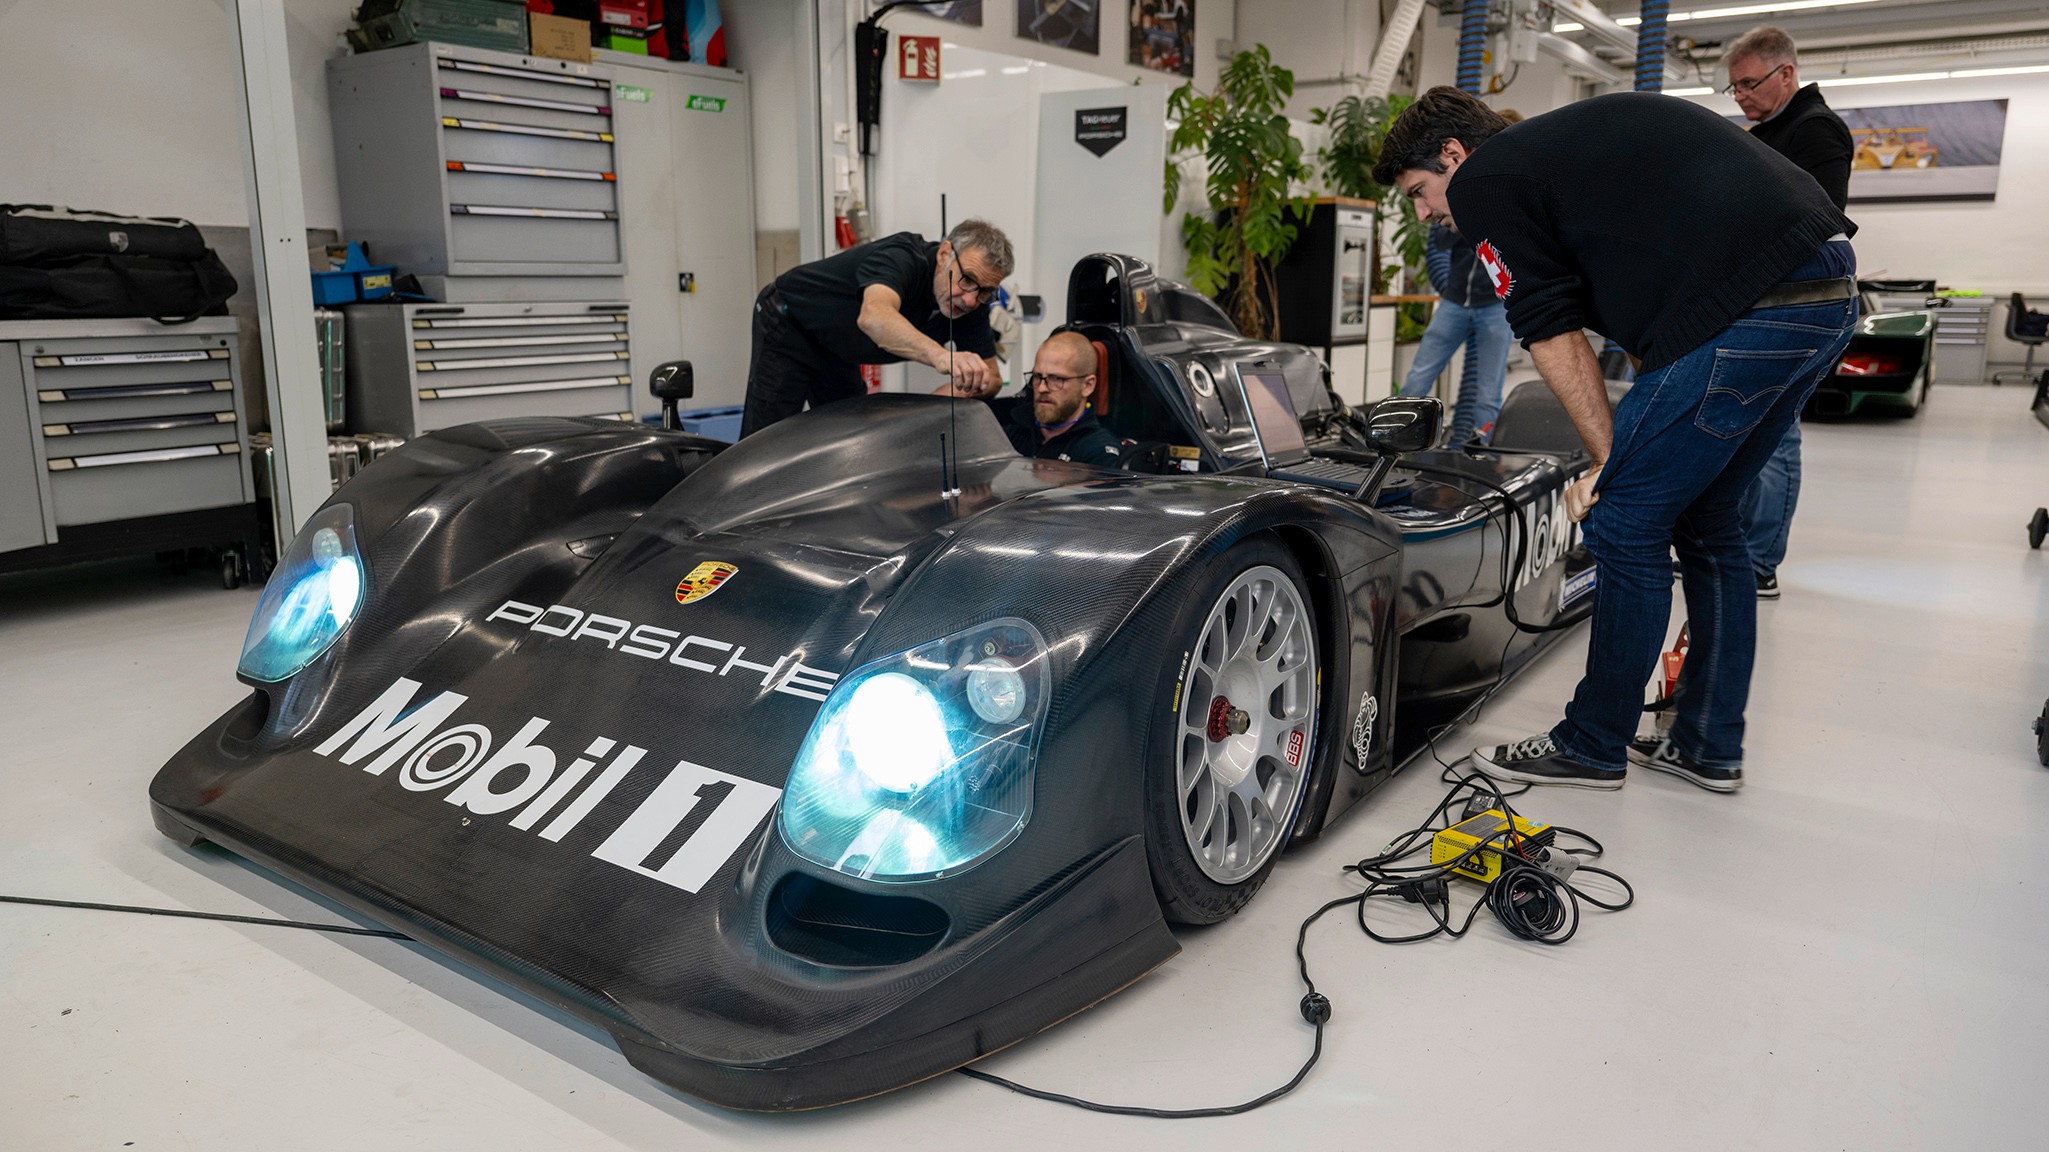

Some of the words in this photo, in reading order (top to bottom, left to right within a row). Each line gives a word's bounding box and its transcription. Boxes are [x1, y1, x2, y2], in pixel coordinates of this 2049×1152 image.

[692, 97, 720, 112] eFuels
[485, 600, 840, 702] PORSCHE
[312, 676, 648, 843] Mobil
[1286, 732, 1302, 766] BBS
